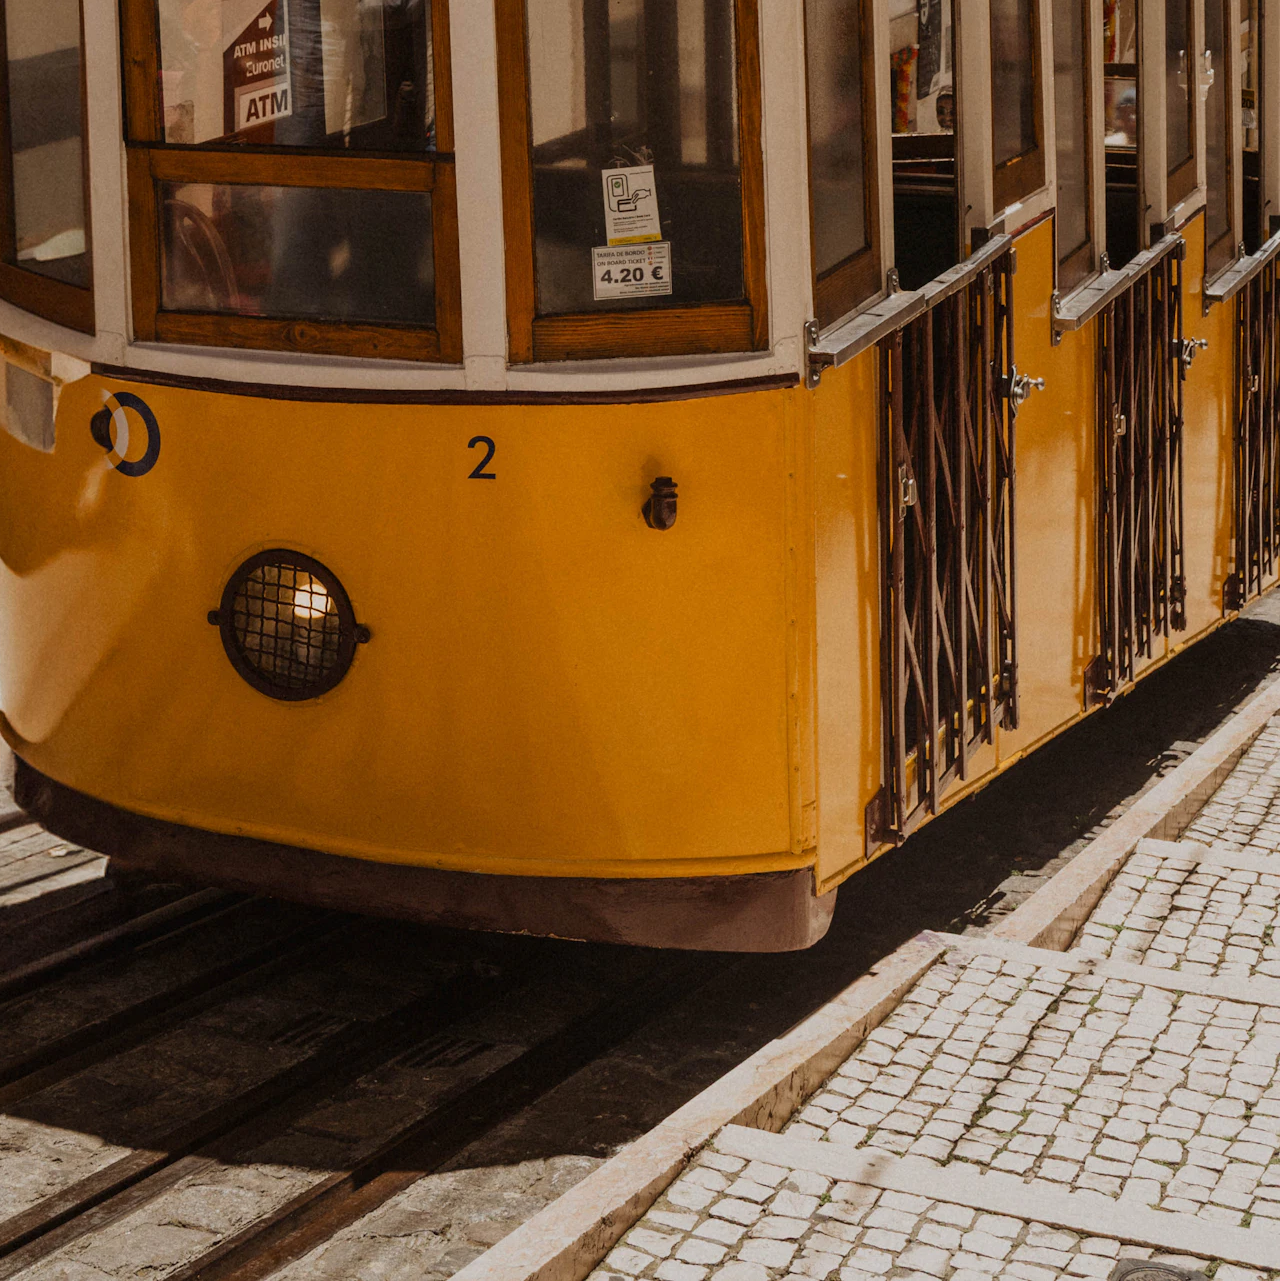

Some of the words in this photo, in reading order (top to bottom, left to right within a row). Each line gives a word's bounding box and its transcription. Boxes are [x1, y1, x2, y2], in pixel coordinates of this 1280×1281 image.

[233, 41, 256, 58] ATM
[246, 54, 285, 77] Euronet
[246, 89, 288, 122] ATM
[601, 268, 644, 284] 4.20
[651, 266, 664, 280] €
[467, 435, 496, 480] 2
